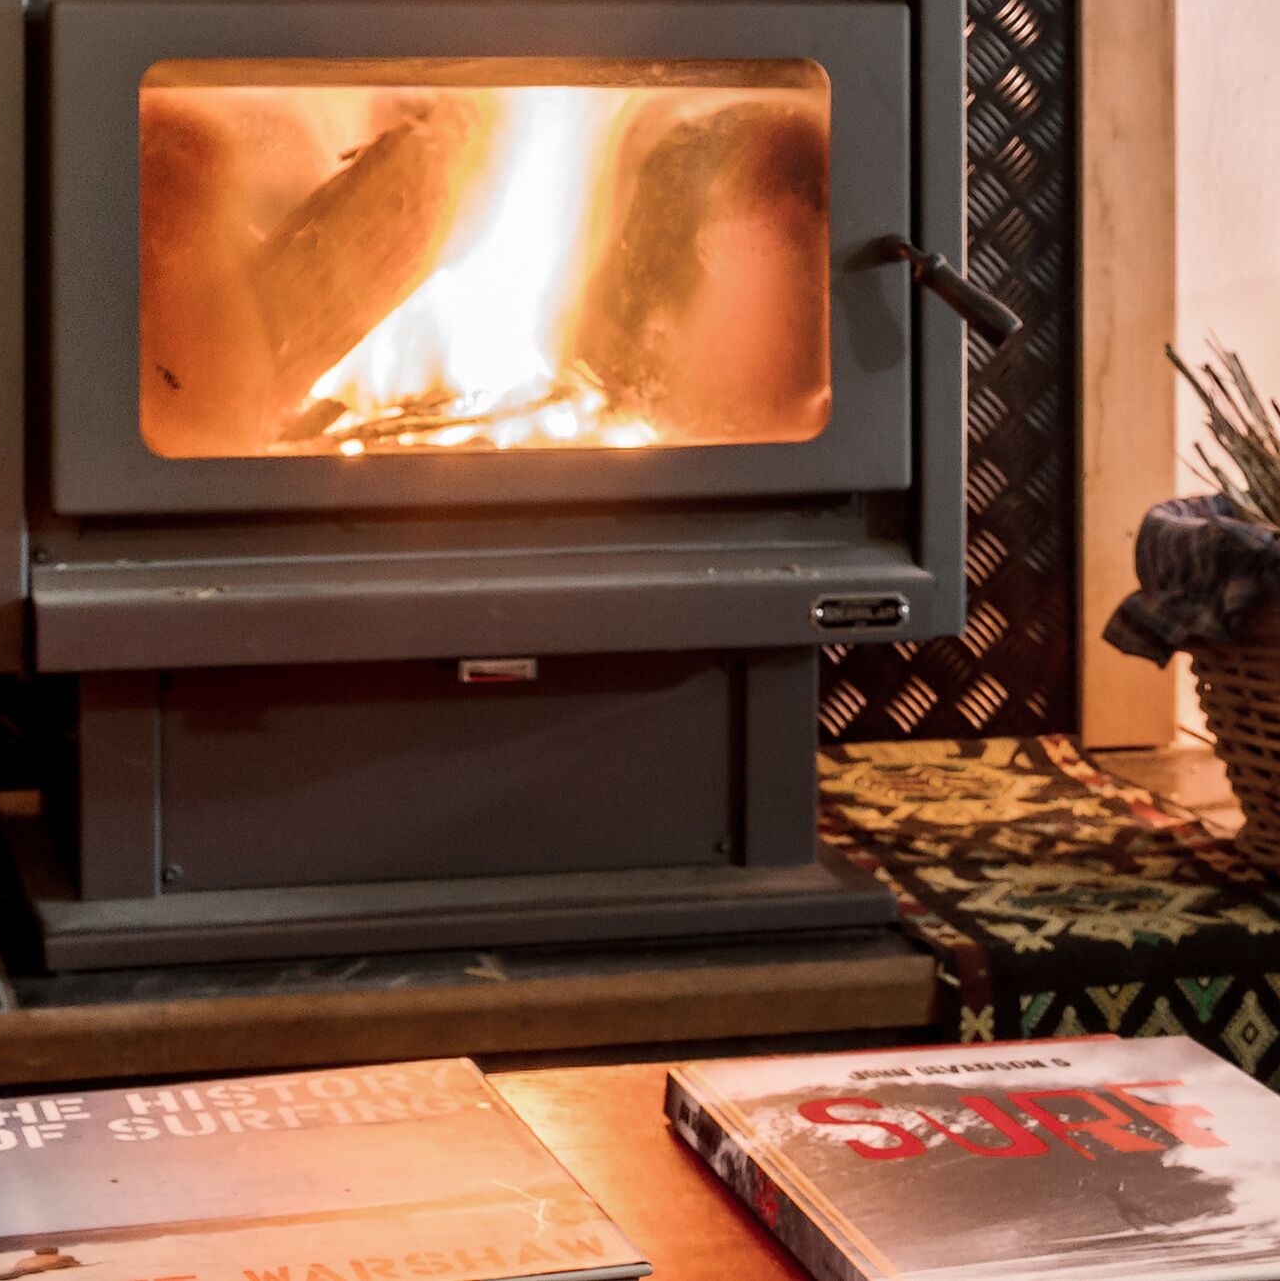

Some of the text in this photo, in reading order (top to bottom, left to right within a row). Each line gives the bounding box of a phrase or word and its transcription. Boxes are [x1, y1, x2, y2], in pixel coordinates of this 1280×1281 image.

[108, 1088, 464, 1142] SURFING
[124, 1065, 454, 1115] HISTORY
[796, 1079, 1229, 1162] SURF
